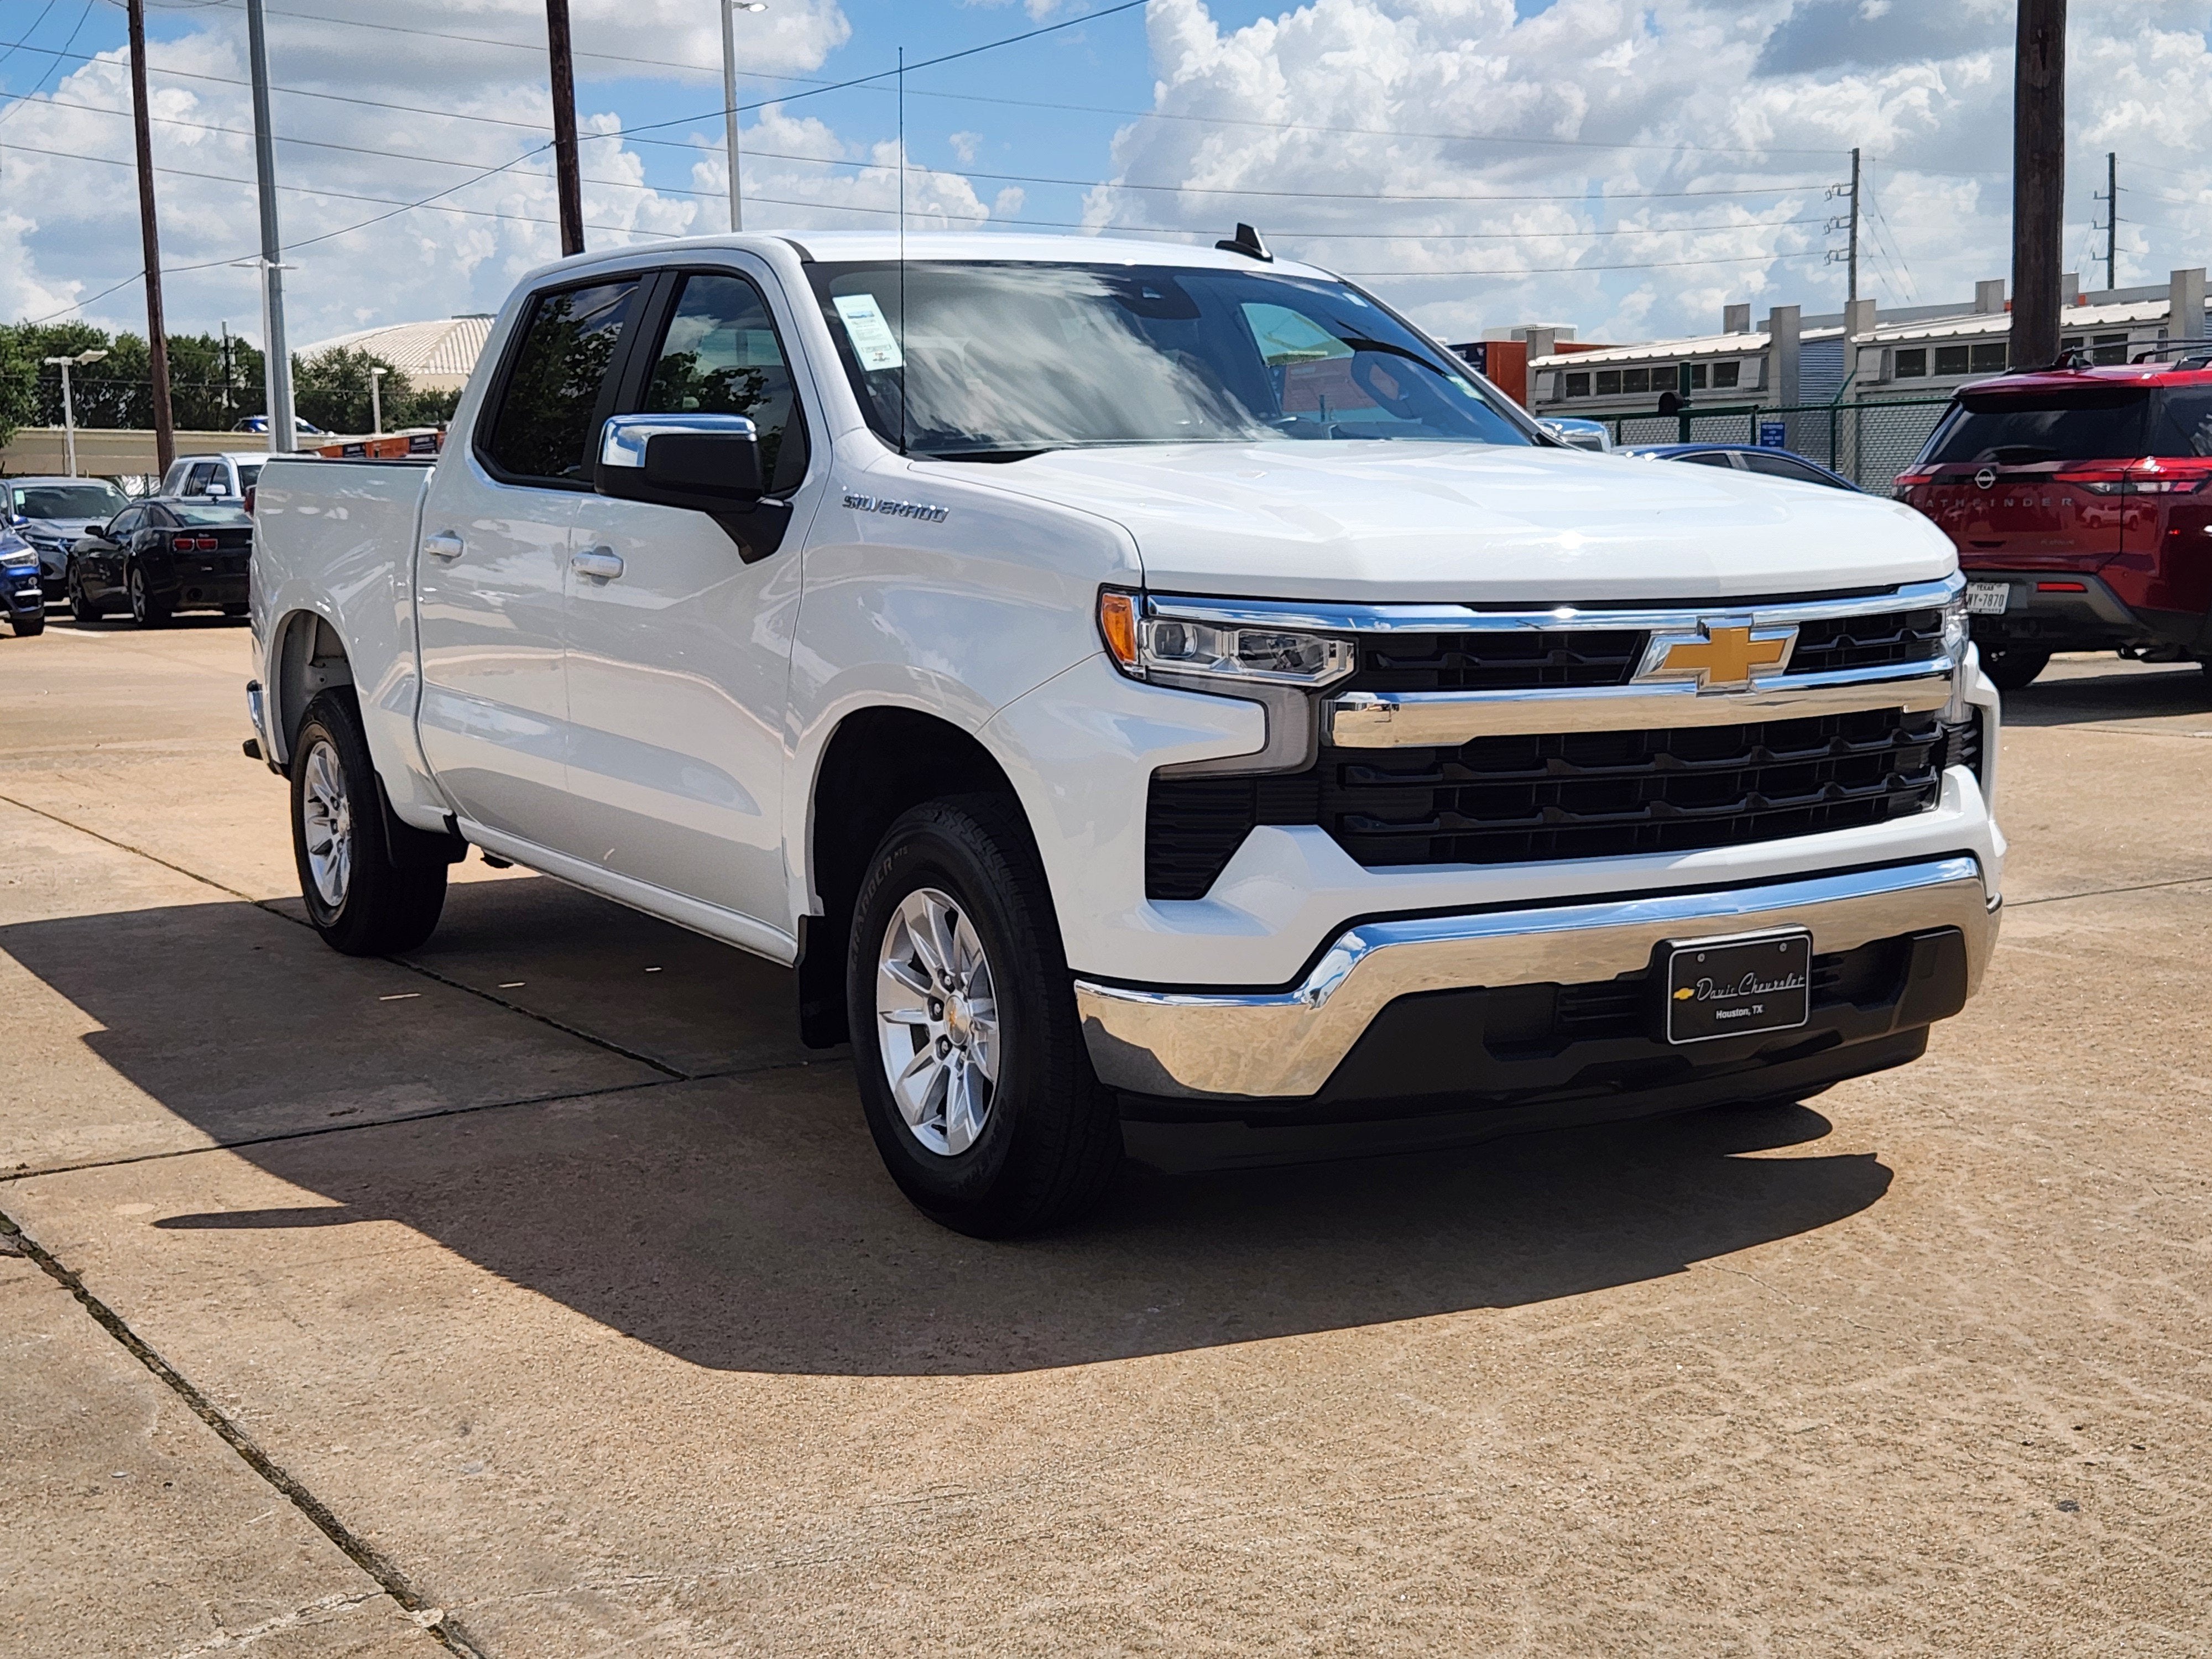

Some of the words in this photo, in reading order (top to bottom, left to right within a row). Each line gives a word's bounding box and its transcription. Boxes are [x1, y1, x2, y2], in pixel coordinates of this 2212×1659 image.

[842, 493, 950, 524] SILVERADO
[1914, 498, 2073, 508] PATHFINDER
[1738, 972, 1805, 997] Chevrolet
[1716, 1007, 1751, 1020] Houston,
[1752, 1004, 1764, 1014] TX
